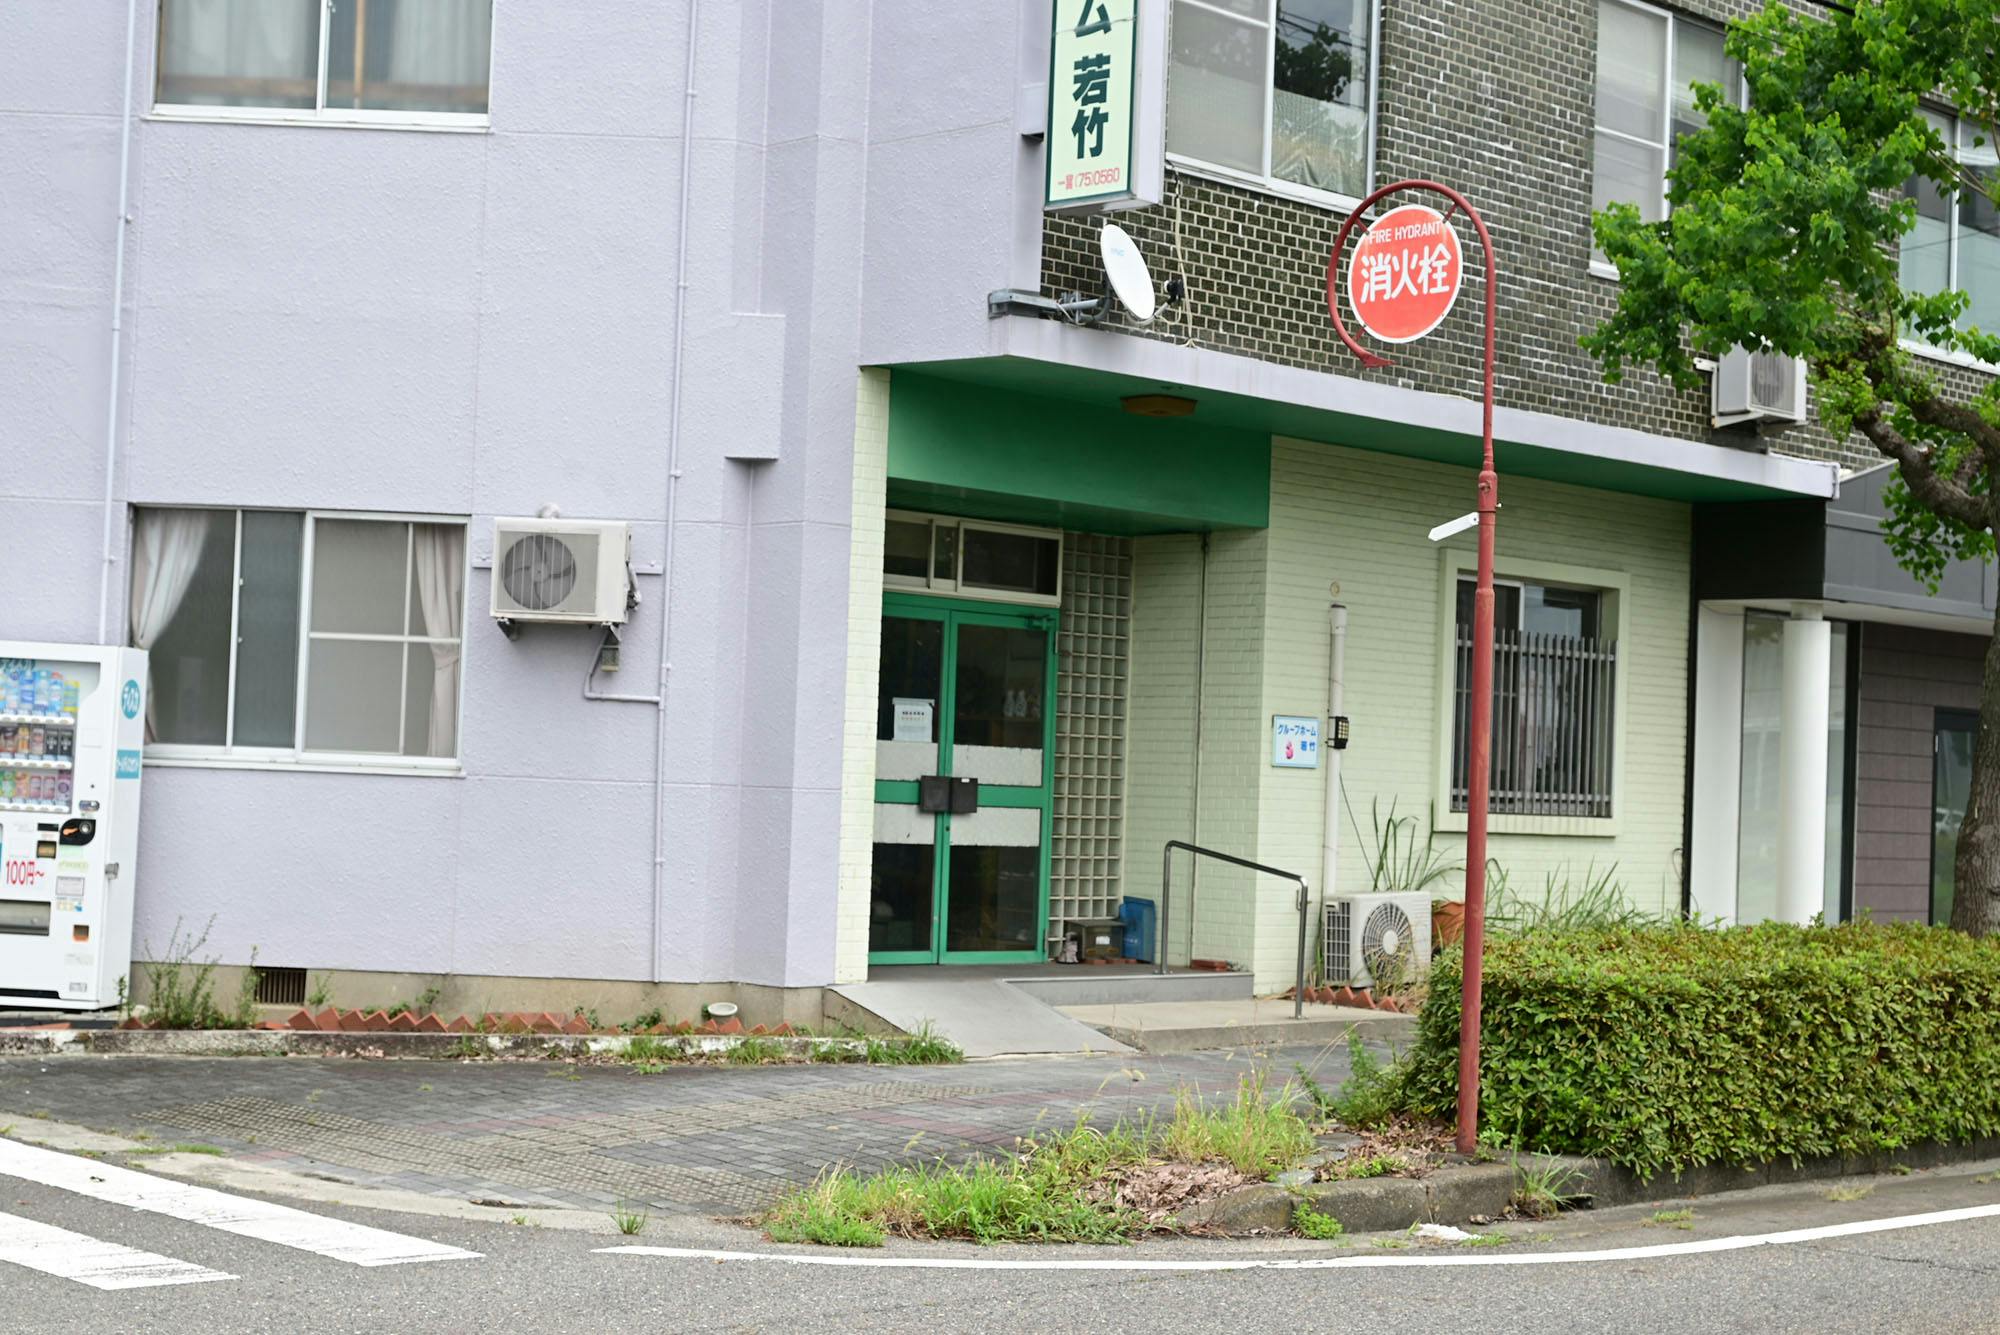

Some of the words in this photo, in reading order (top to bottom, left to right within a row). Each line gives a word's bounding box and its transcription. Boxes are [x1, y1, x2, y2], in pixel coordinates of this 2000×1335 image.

[1369, 227, 1392, 245] FIRE
[1394, 221, 1442, 241] HYDRANT
[1360, 242, 1452, 304] 消火栓
